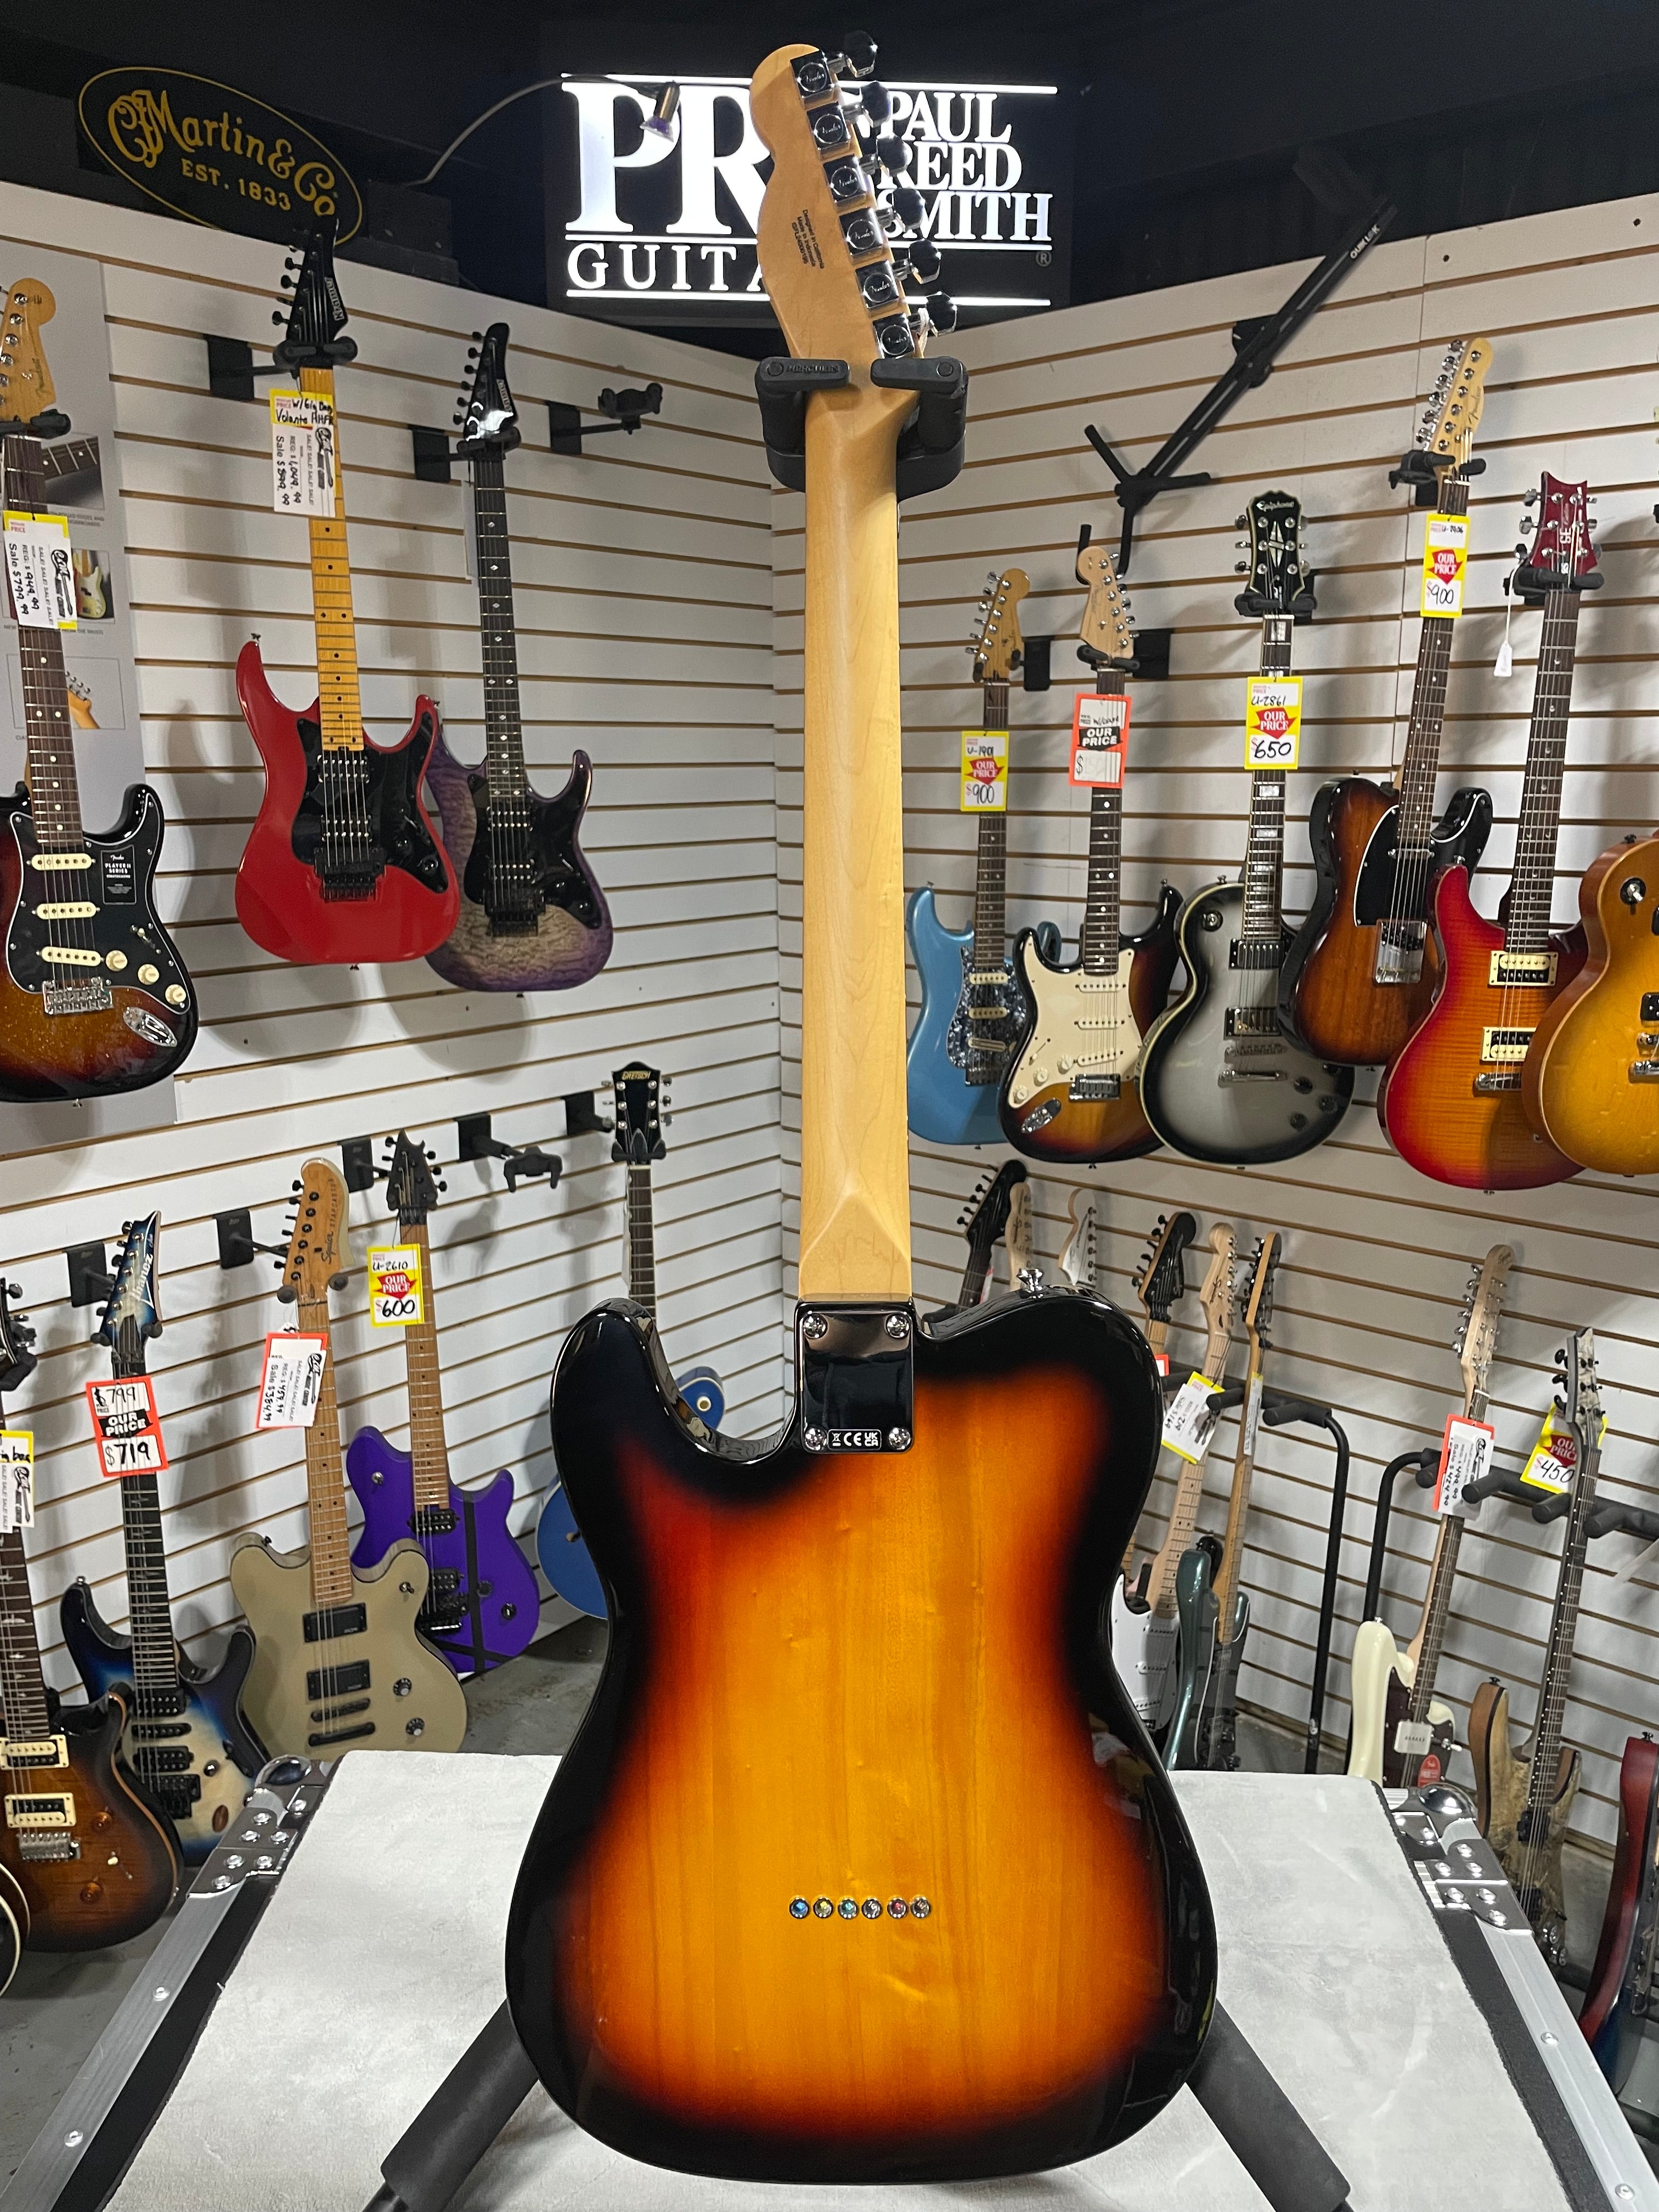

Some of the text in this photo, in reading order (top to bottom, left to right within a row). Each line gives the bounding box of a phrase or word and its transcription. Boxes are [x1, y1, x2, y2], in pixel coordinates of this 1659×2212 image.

[877, 90, 1012, 143] PAUL
[562, 82, 872, 235] PR
[239, 178, 291, 211] 1833
[276, 435, 284, 458] Sale
[9, 543, 19, 567] Sale
[1437, 552, 1455, 565] OUR
[1434, 563, 1457, 575] PRICE
[1264, 710, 1285, 721] OUR
[1086, 727, 1113, 738] OUR
[1260, 720, 1289, 731] PRICE
[1082, 735, 1118, 747] PRICE
[976, 761, 995, 769] OUR
[973, 769, 998, 778] PRICE
[321, 1231, 336, 1265] Squier
[128, 1252, 154, 1301] Ibanez
[385, 1274, 407, 1285] OUR
[382, 1282, 411, 1293] PRICE
[269, 1364, 278, 1383] Sale
[108, 1412, 138, 1426] OUR
[105, 1419, 146, 1436] PRICE
[844, 1432, 862, 1446] CE
[105, 1442, 151, 1466] $719
